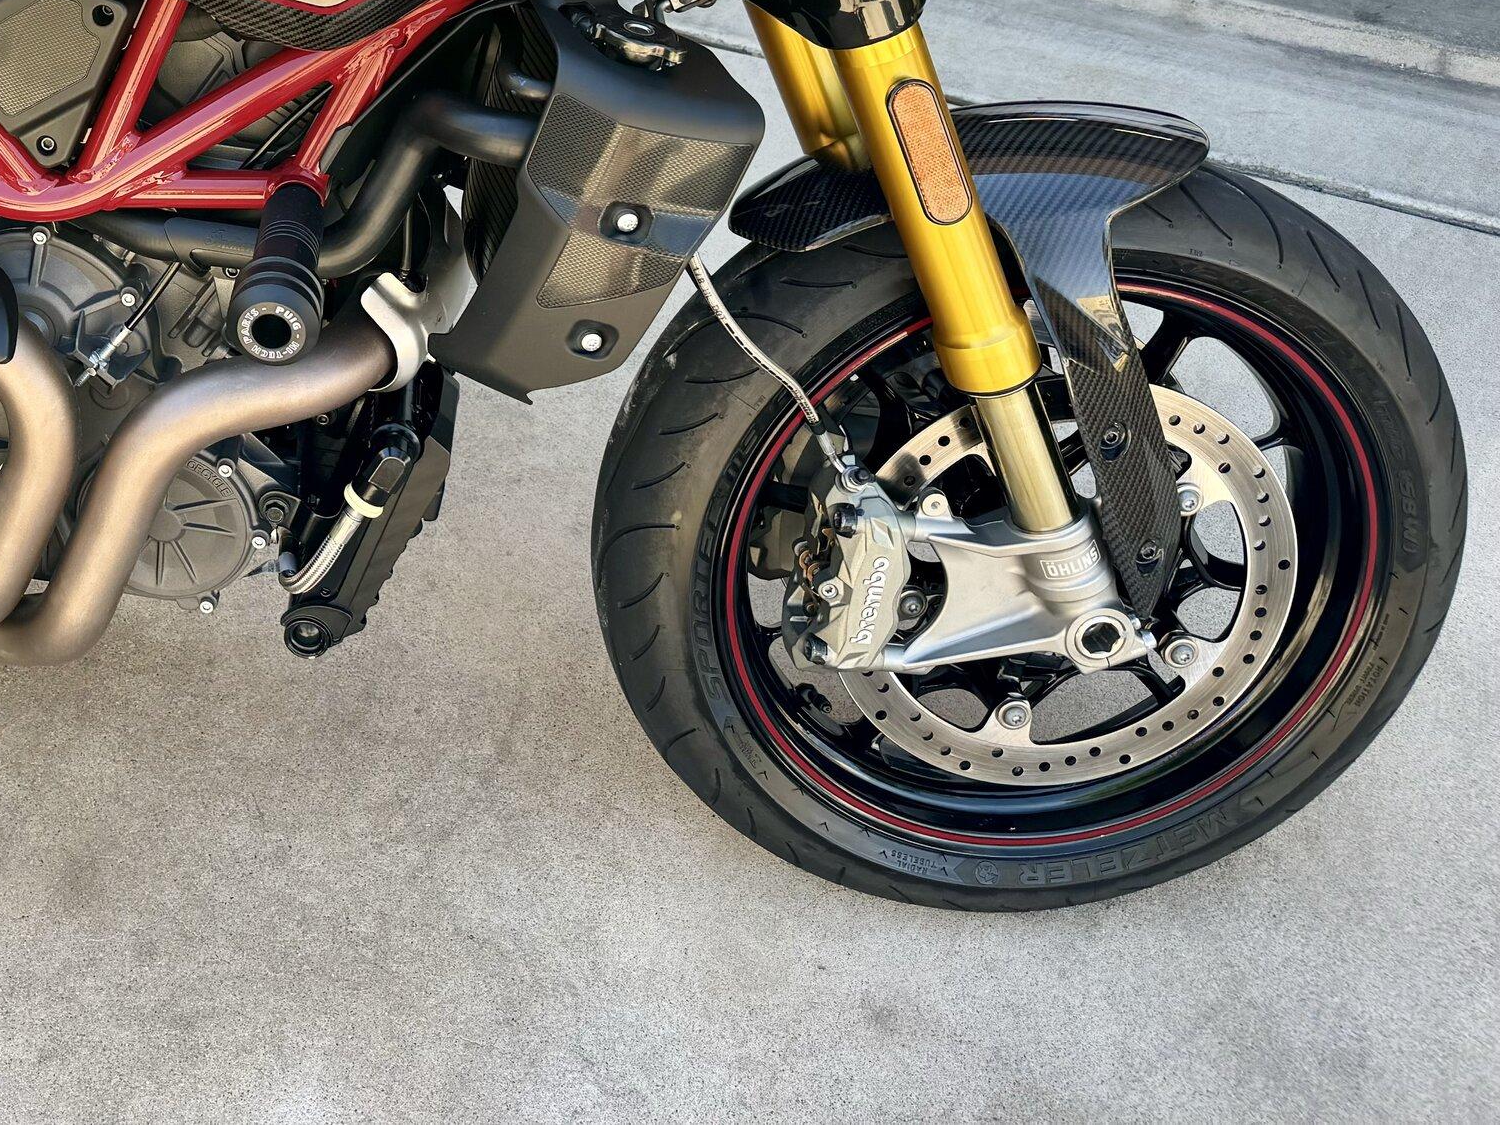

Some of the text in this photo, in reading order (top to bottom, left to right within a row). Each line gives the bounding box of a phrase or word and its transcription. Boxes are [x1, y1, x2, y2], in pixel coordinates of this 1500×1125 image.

[241, 308, 259, 345] PARTS
[275, 306, 302, 331] PUIG
[1046, 546, 1098, 577] ÖHLINS
[850, 556, 890, 645] brembo
[1019, 807, 1228, 884] METZELER
